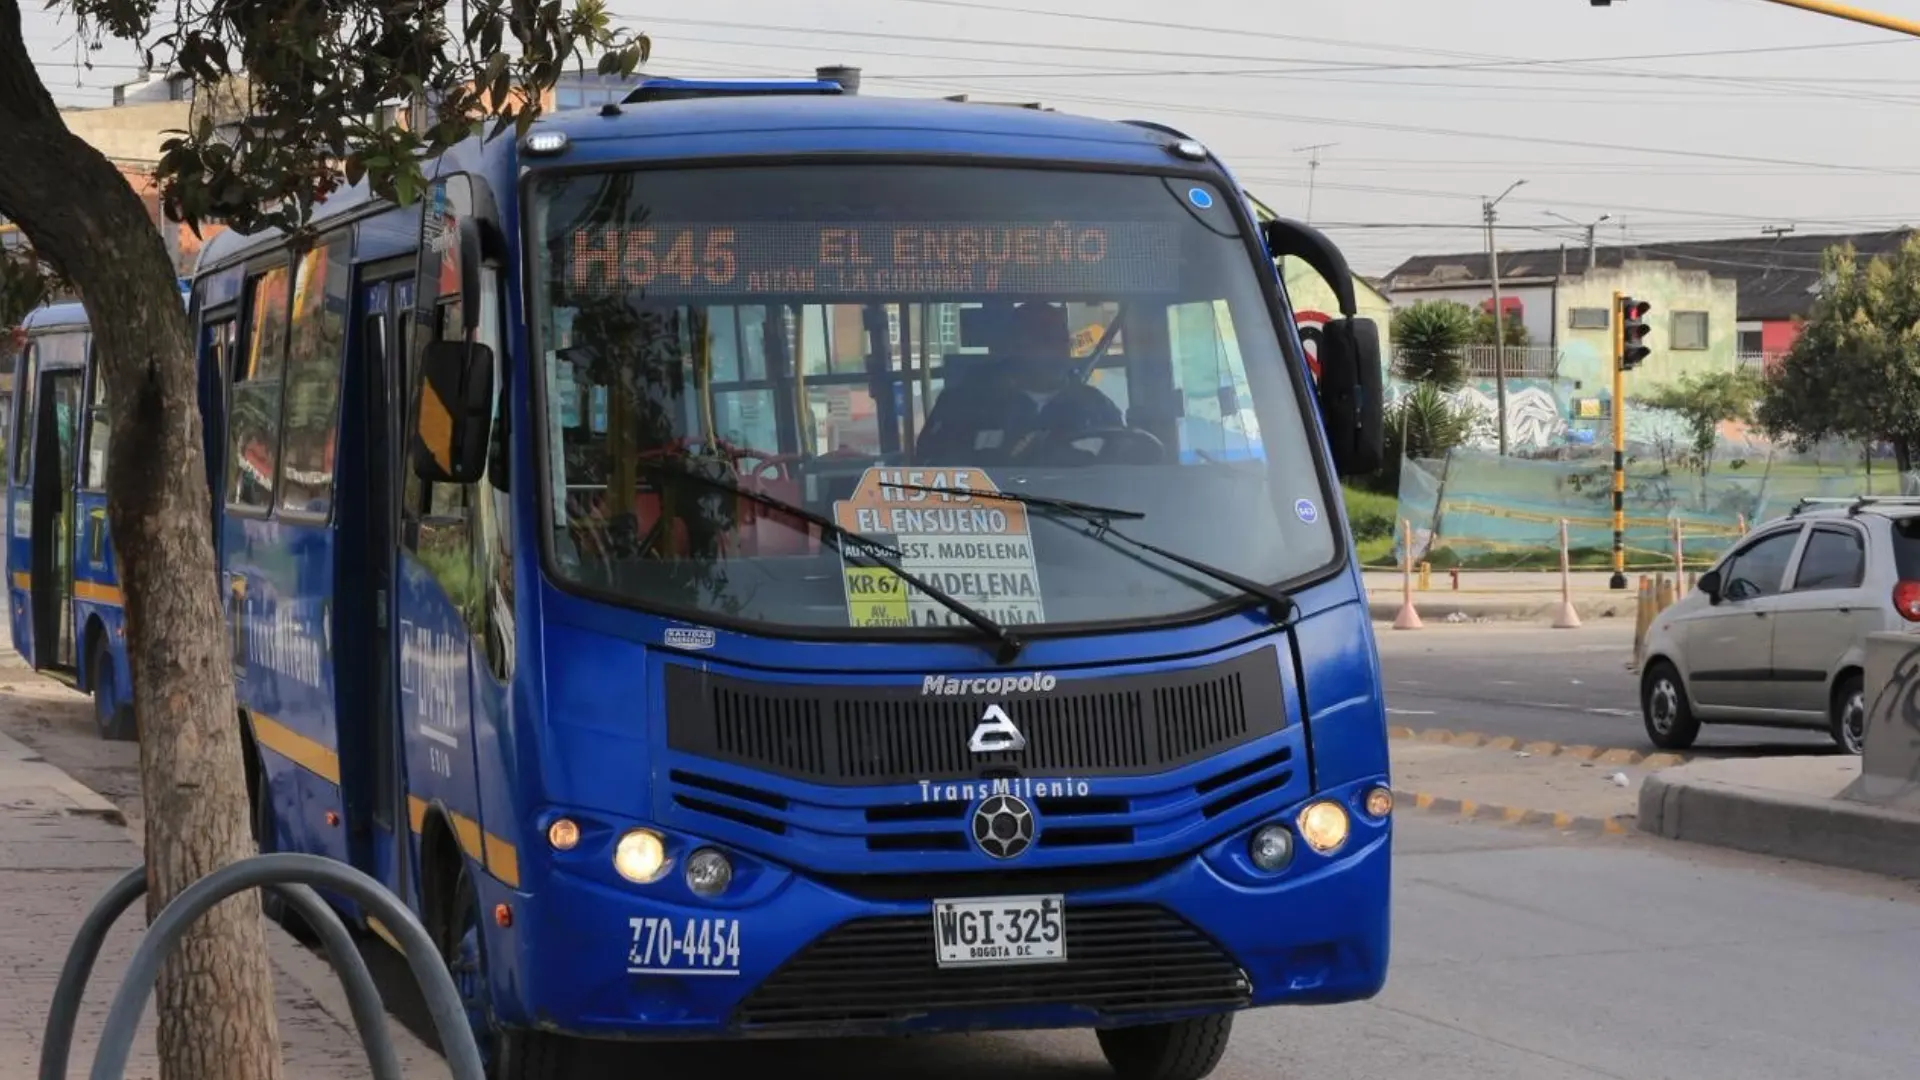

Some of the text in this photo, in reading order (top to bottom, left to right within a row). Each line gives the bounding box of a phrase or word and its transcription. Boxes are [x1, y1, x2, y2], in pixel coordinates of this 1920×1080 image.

[819, 220, 1108, 264] EL ENSUEÑO
[573, 226, 736, 293] H545
[879, 470, 972, 502] H545
[855, 503, 1006, 533] EL ENSUEÑO
[900, 542, 1029, 559] EST. MADELENA
[848, 574, 899, 594] KR 67
[908, 572, 1035, 597] MADELENA
[871, 604, 889, 618] AV.
[922, 673, 1056, 696] Marcopolo
[918, 777, 1089, 802] TransMilenio
[969, 946, 1010, 958] BOGOTA
